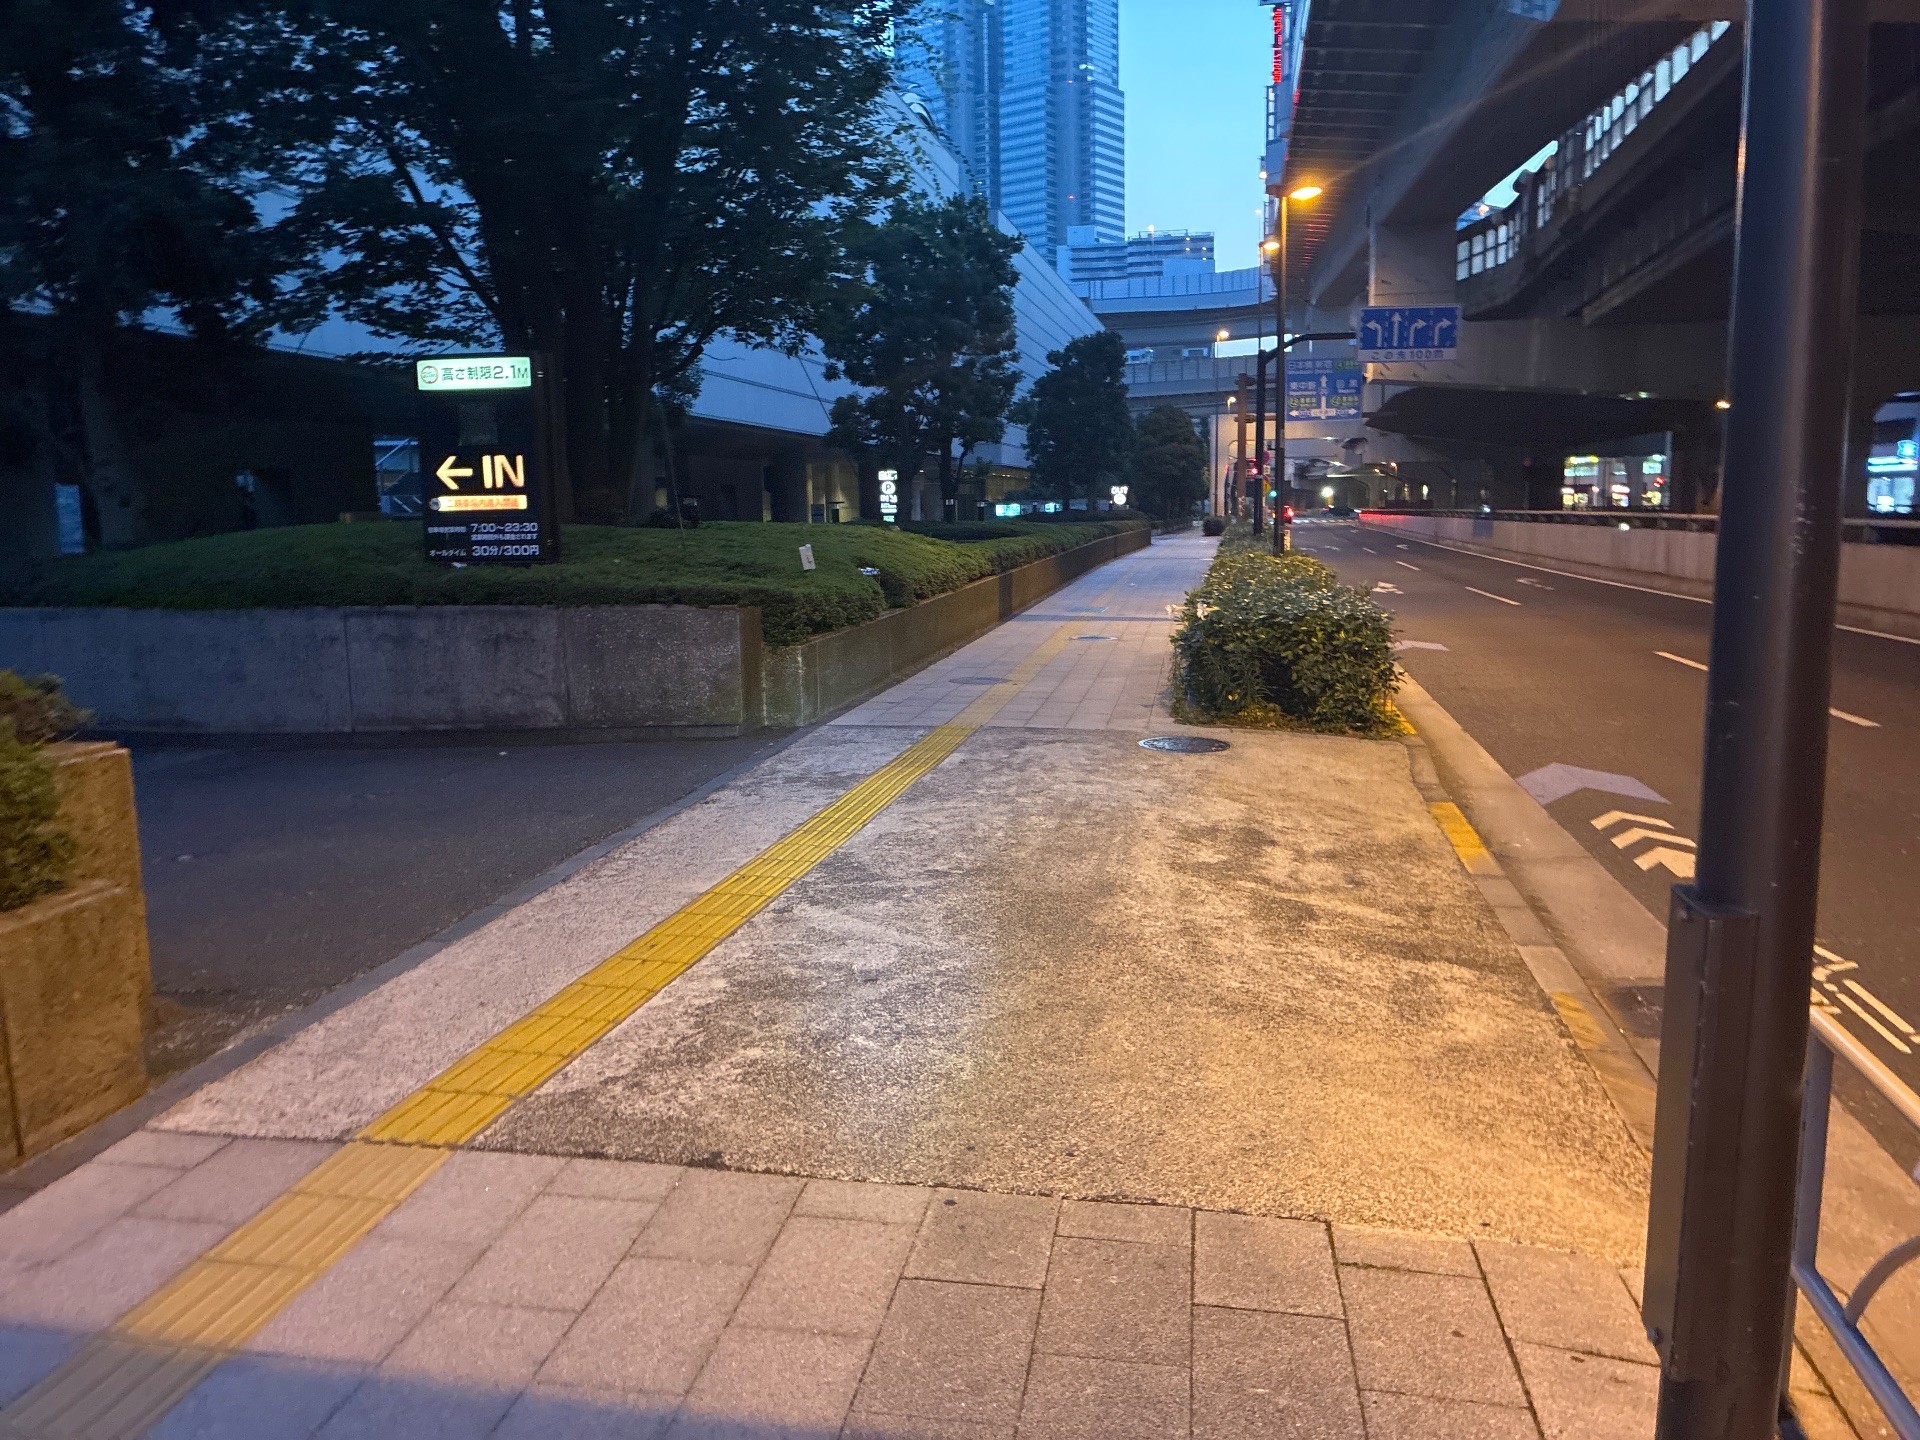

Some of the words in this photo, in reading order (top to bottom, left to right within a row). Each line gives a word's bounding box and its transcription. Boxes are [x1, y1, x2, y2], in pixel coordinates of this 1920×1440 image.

[481, 454, 525, 489] IN
[1110, 486, 1128, 494] OUT
[429, 548, 467, 557] オールタイム
[472, 544, 540, 556] 30分/300円
